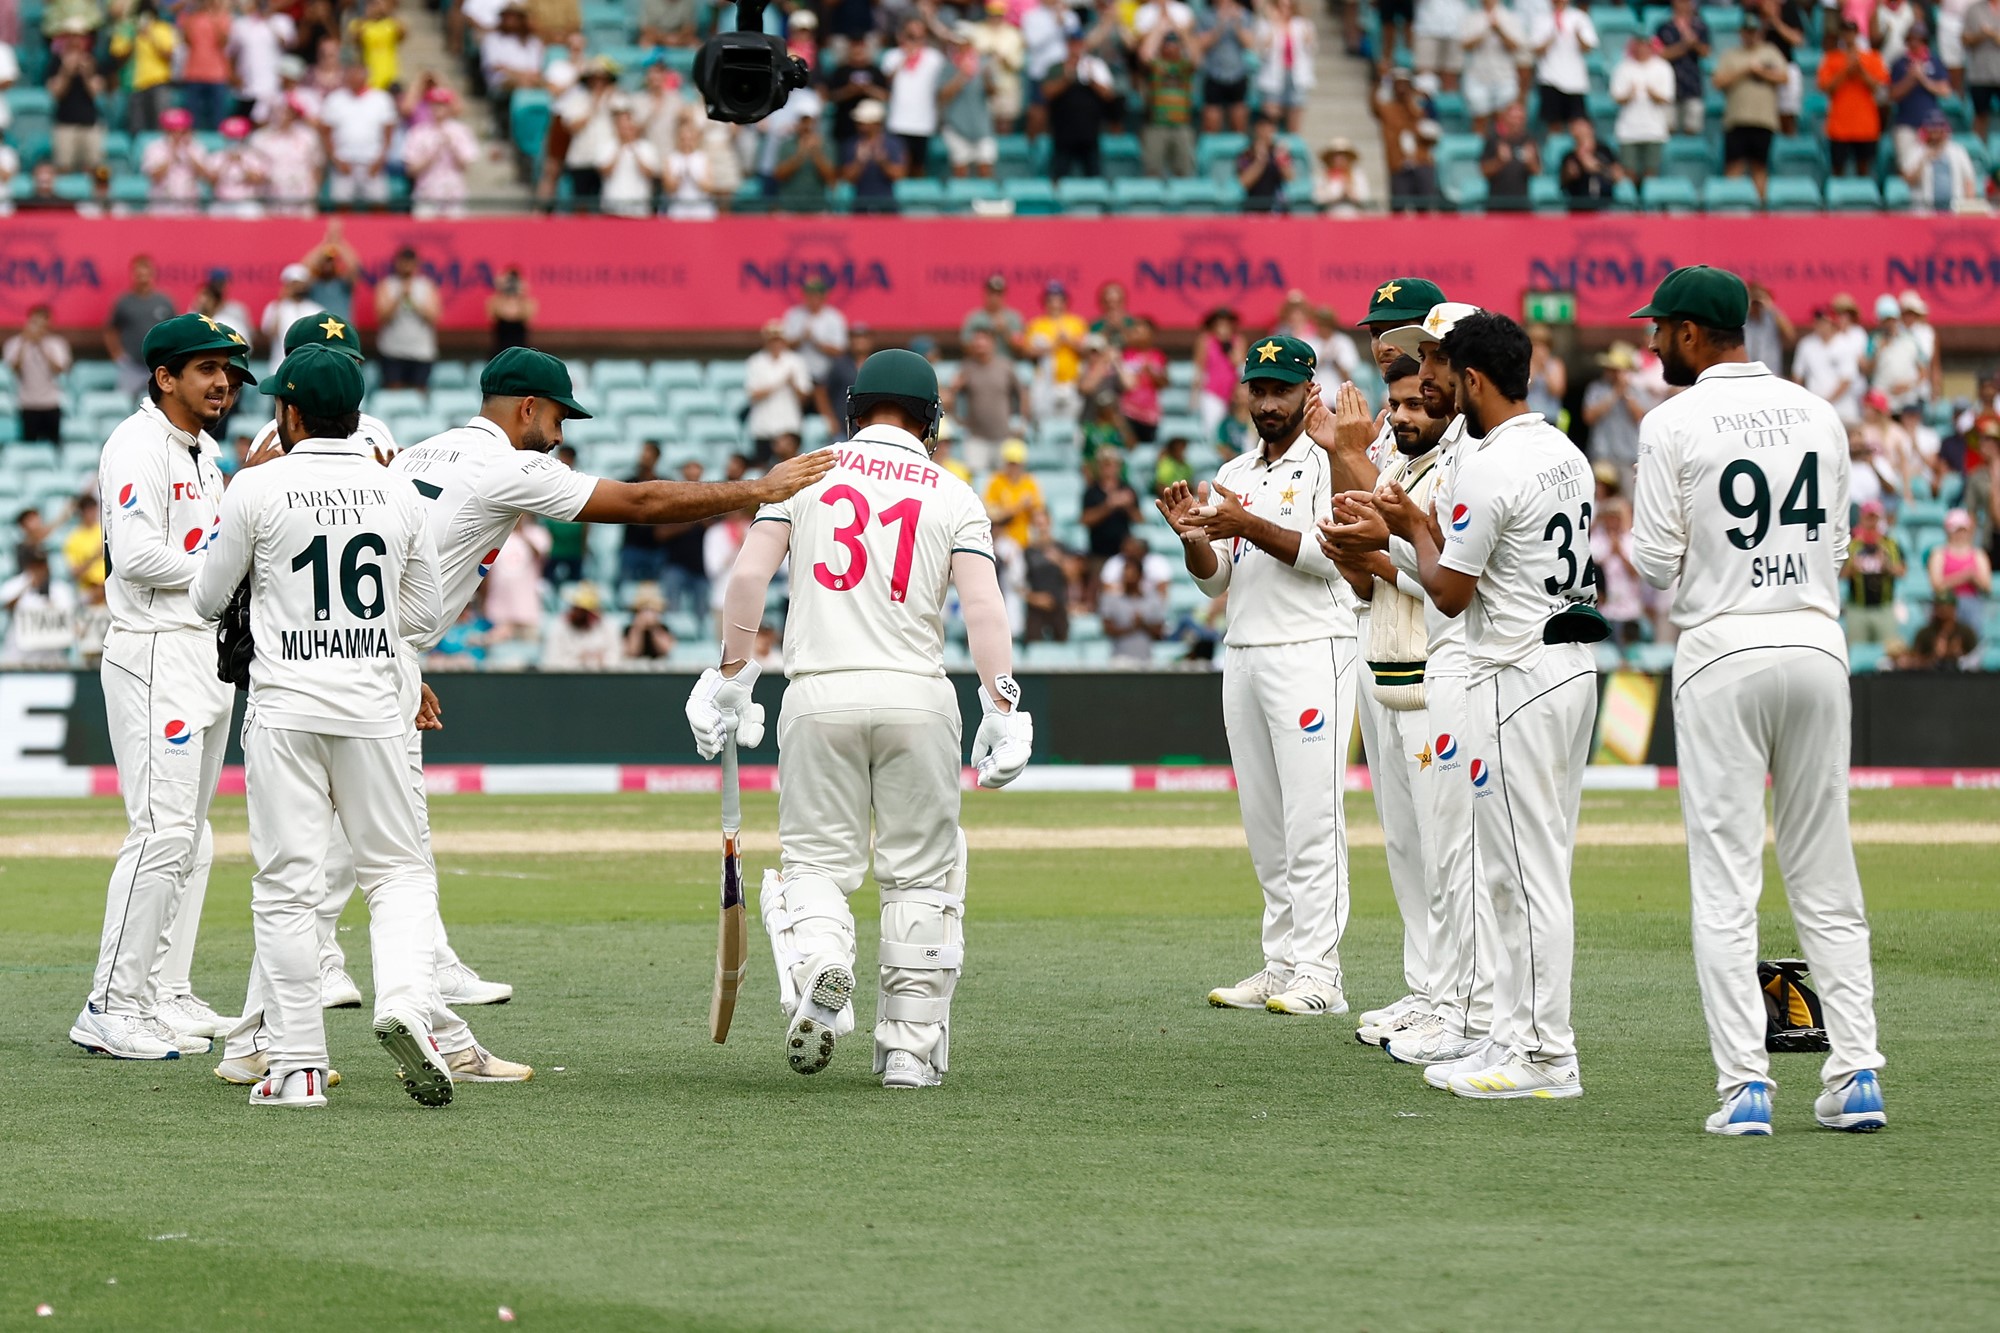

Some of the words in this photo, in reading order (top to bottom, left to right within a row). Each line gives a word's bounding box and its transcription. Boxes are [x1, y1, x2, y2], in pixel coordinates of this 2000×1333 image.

[0, 258, 103, 290] RMA
[740, 258, 891, 291] NRMA
[1135, 258, 1285, 290] NRMA
[1887, 257, 2000, 288] NRM
[1713, 407, 1811, 434] PARKVIEW
[1743, 427, 1791, 450] CITY
[837, 449, 940, 489] WARNER
[286, 488, 390, 510] PARKVIEW
[1280, 507, 1292, 516] 244
[1719, 451, 1827, 550] 94
[315, 506, 366, 527] CITY
[813, 484, 922, 604] 31
[1543, 502, 1597, 596] 32
[291, 532, 387, 622] 16
[281, 628, 396, 661] MUHAMMA
[165, 748, 190, 756] pepsi
[1302, 735, 1326, 744] pepsi
[1438, 762, 1461, 773] pepsi
[926, 949, 939, 957] DSC
